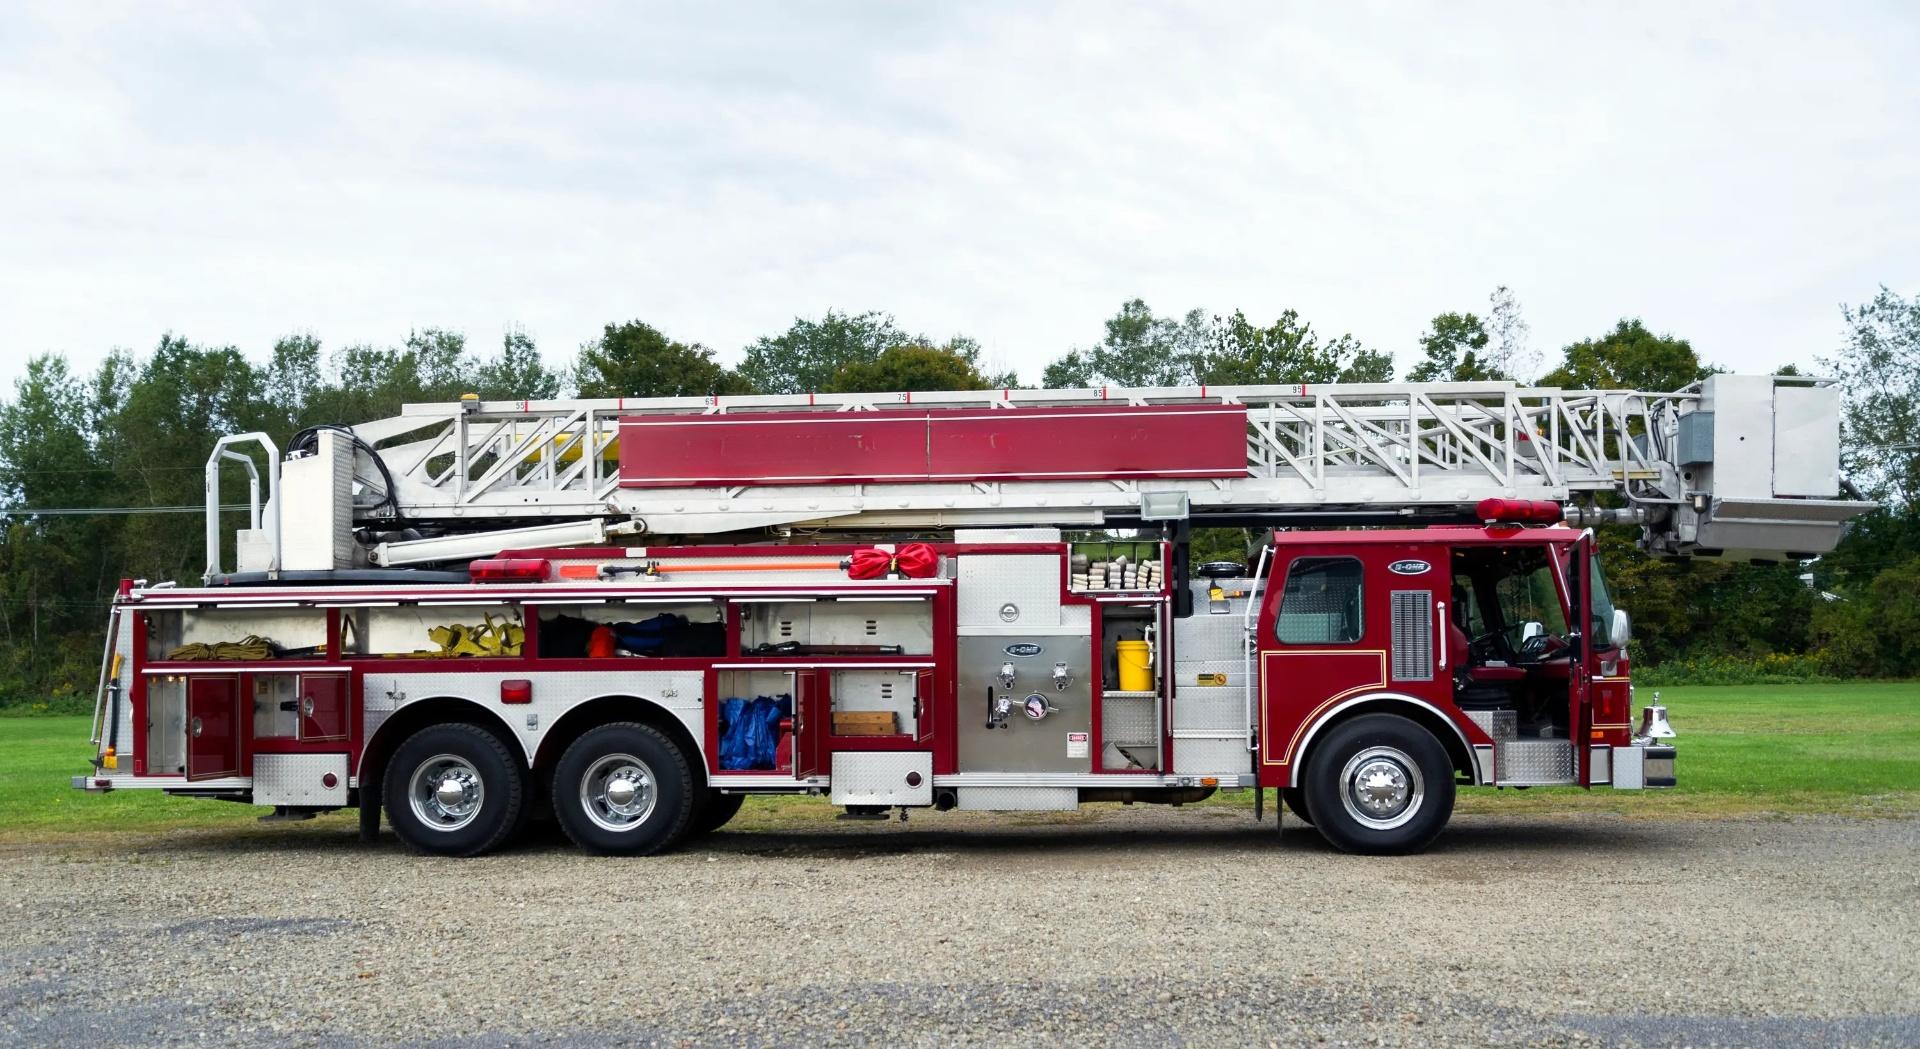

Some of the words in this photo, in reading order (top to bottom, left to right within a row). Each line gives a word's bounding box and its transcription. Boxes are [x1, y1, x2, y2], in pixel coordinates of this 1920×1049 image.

[1093, 389, 1103, 397] 85
[1292, 385, 1302, 394] 95
[705, 397, 714, 405] 65
[897, 393, 906, 401] 75
[515, 401, 525, 410] 55
